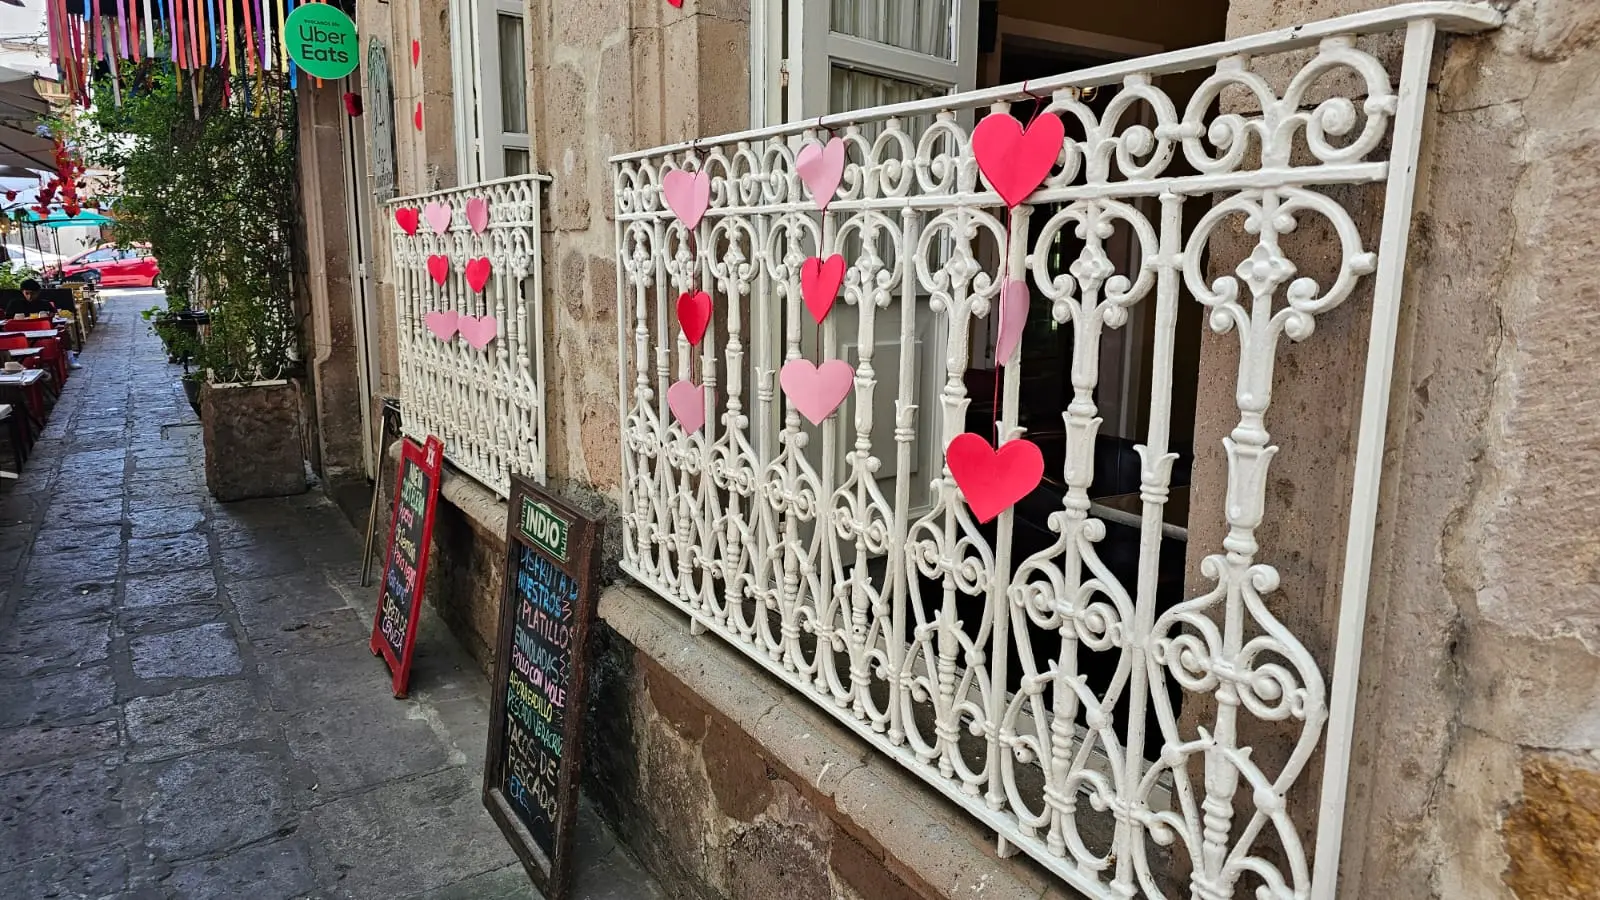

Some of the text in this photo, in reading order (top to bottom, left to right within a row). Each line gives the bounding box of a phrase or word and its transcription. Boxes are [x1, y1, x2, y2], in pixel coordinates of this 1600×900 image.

[299, 24, 347, 45] Uber
[301, 43, 349, 63] Eats
[526, 506, 560, 548] INDIO
[520, 543, 566, 592] DISFRUTA
[518, 570, 562, 618] NUESTROS
[512, 645, 566, 708] POLLO CON MOLE
[514, 626, 559, 681] ENMOLADAS
[507, 686, 532, 731] PESCADO
[507, 715, 557, 786] TACOS DE
[508, 744, 557, 823] PESCADO
